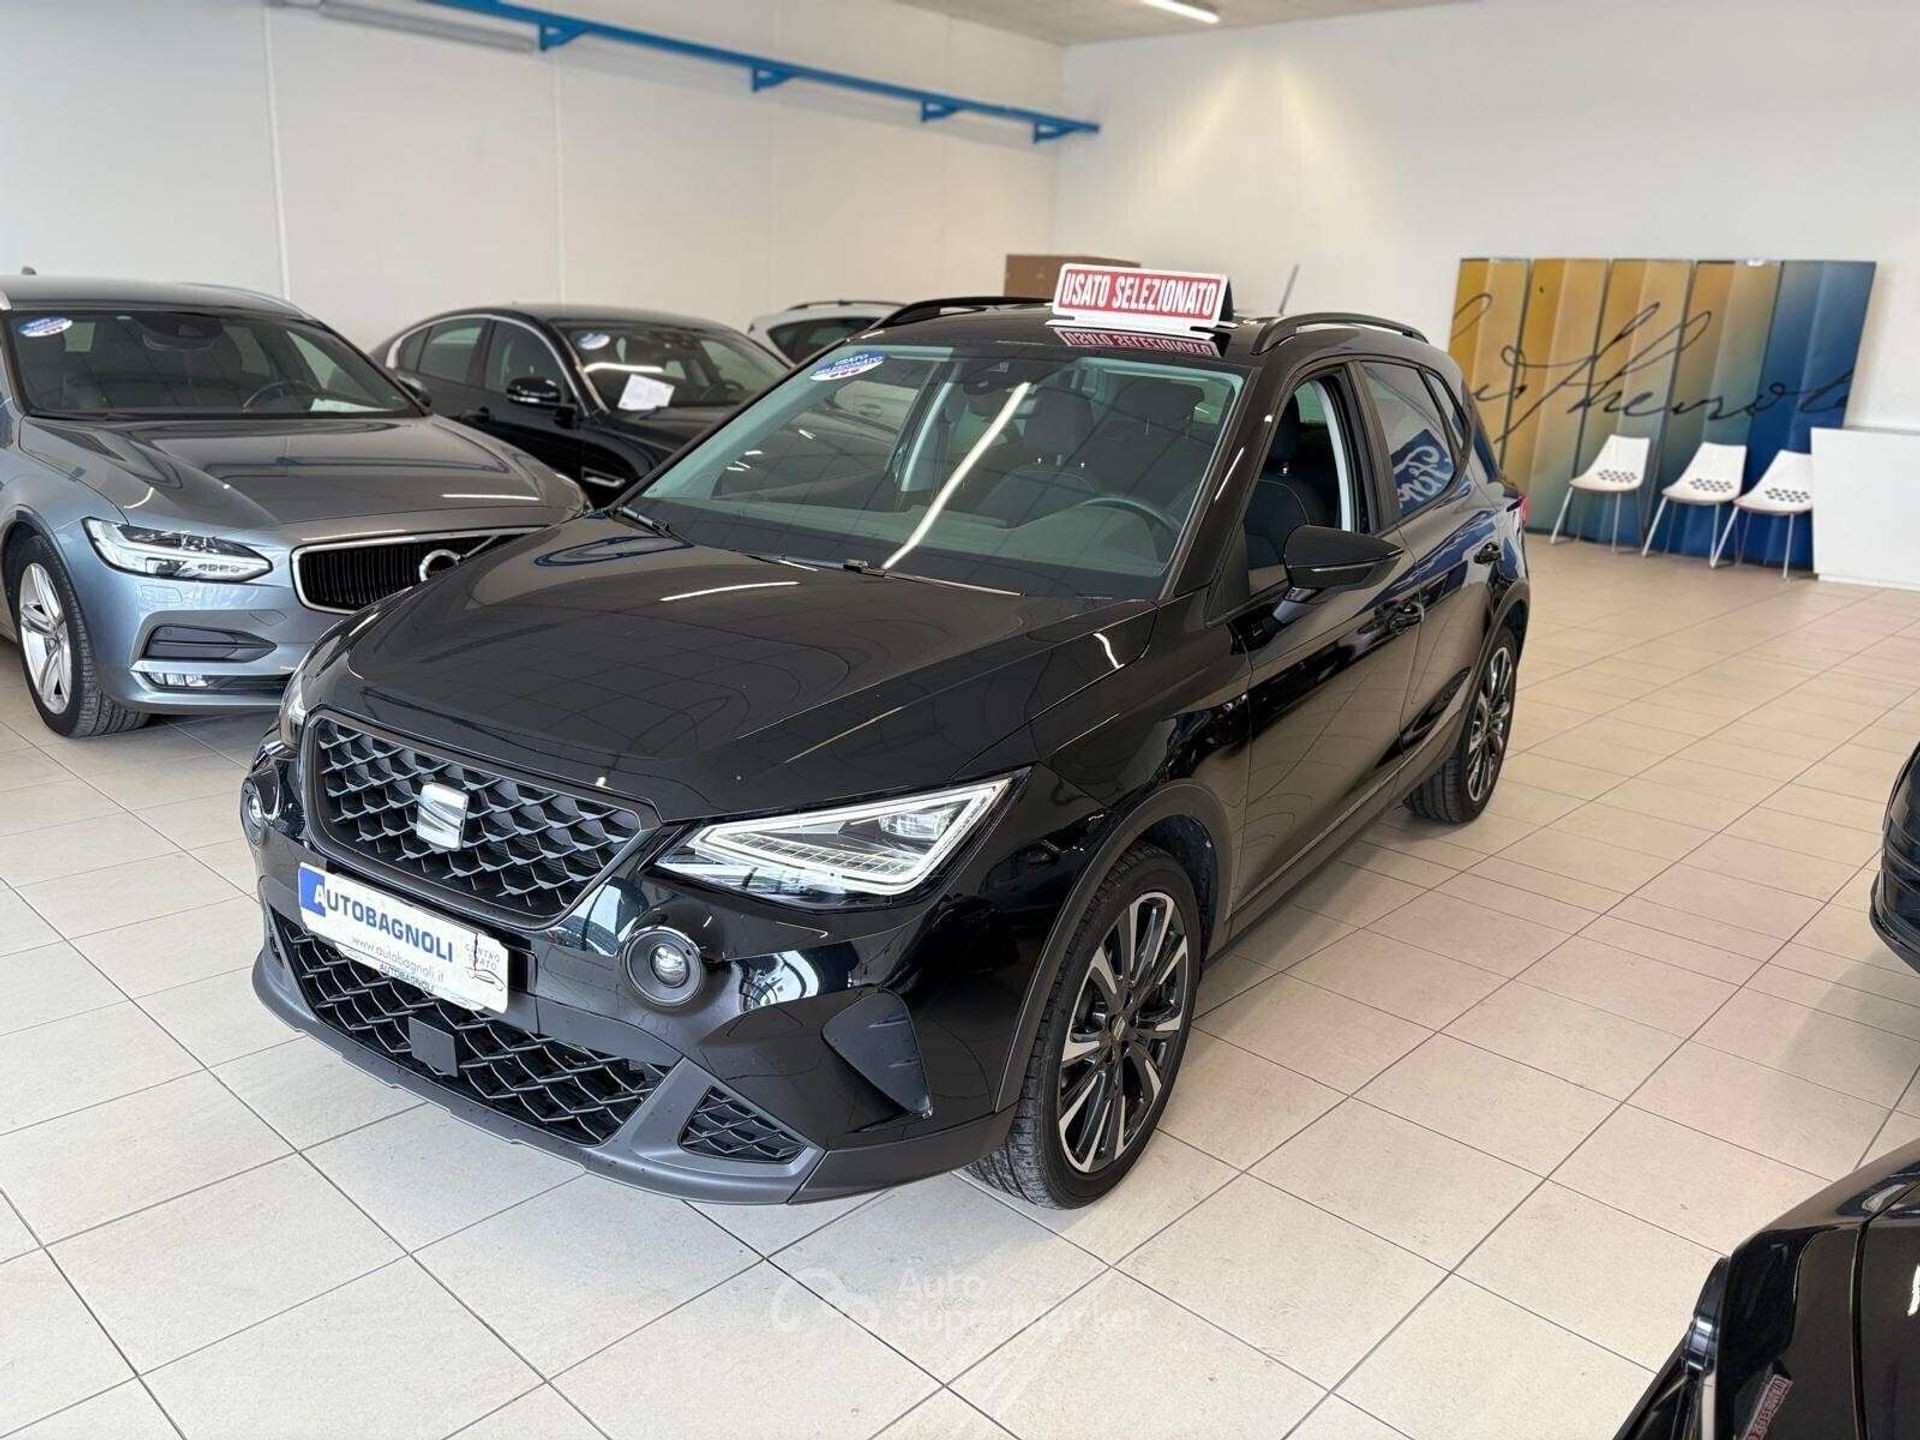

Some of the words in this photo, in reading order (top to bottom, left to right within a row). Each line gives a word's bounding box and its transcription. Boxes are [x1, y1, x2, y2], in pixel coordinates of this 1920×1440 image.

[1061, 273, 1111, 307] USATO
[1112, 275, 1218, 316] SELEZIONATO
[314, 884, 453, 963] AUTOBAGNOLI
